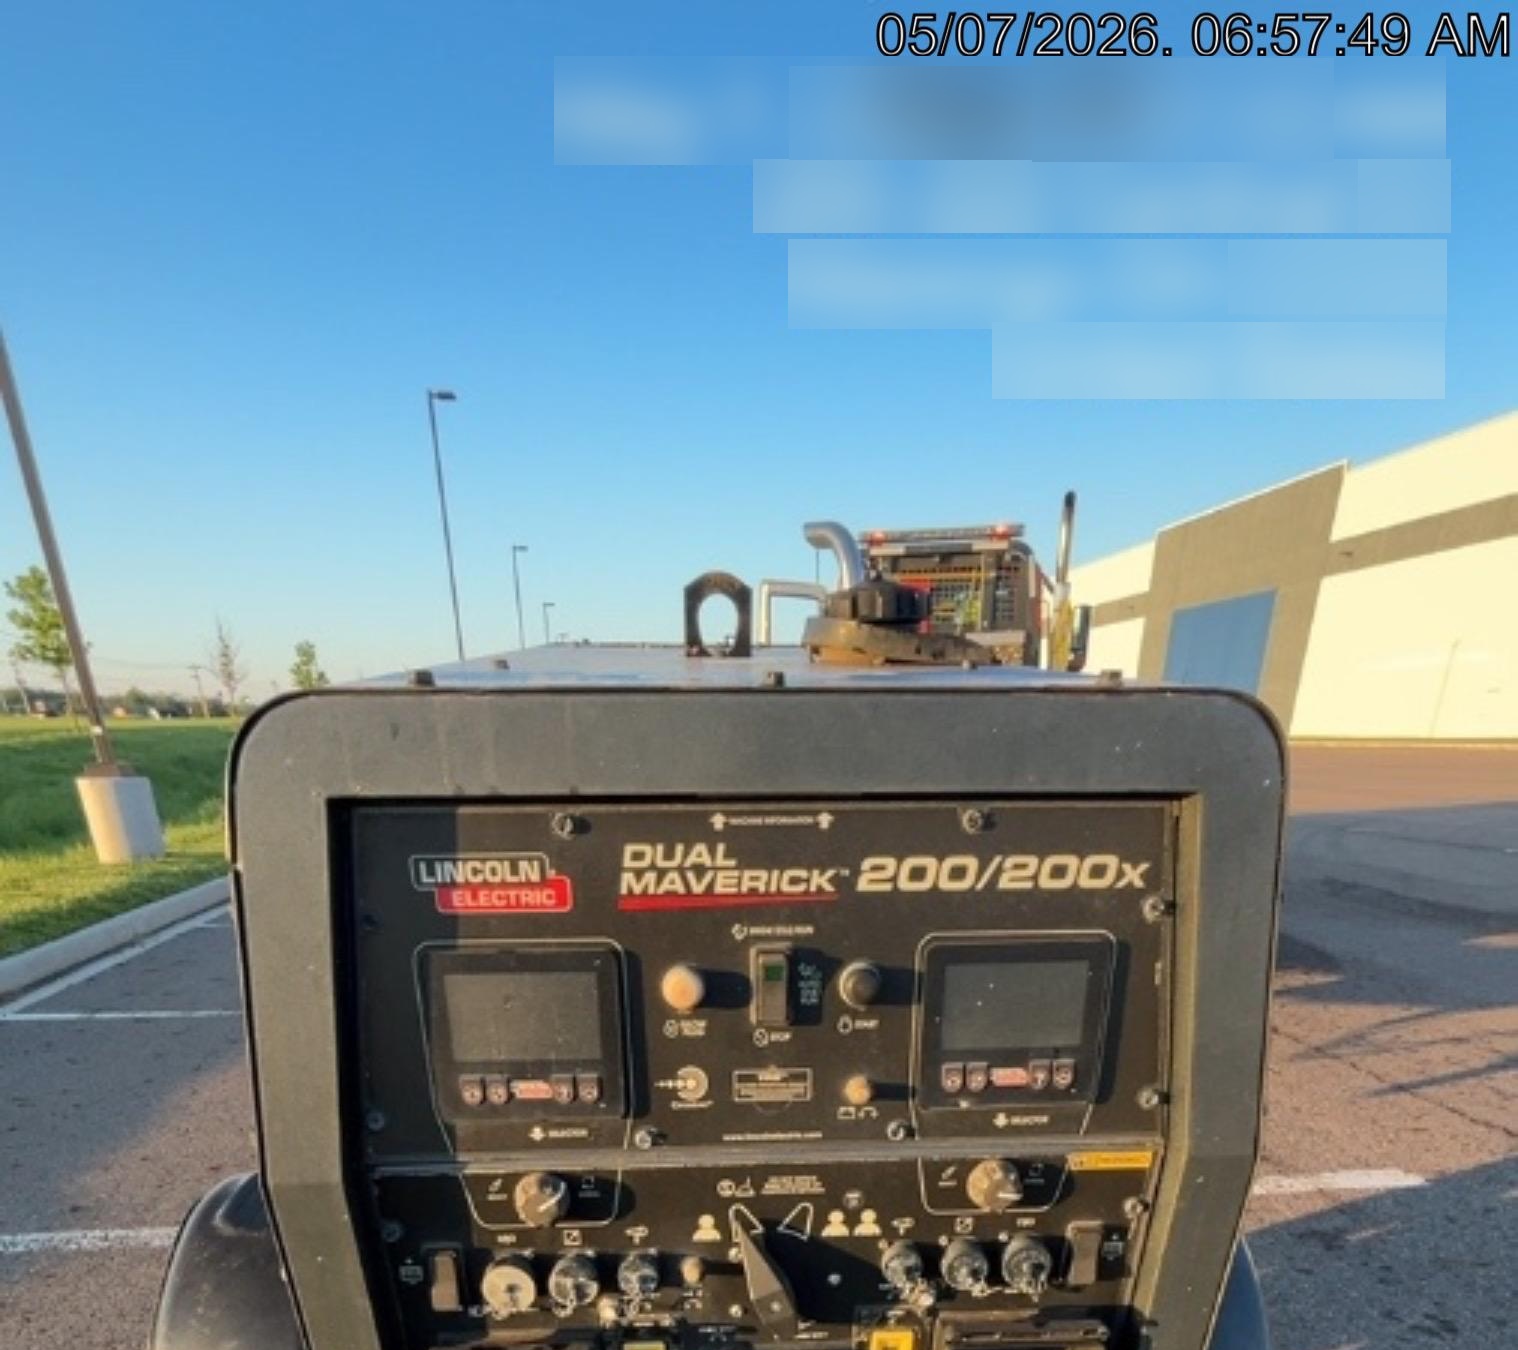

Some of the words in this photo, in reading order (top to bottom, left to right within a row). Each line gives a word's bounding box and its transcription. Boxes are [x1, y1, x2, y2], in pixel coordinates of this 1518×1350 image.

[623, 842, 737, 868] DUAL
[418, 859, 541, 883] LINCOLN
[856, 853, 1150, 892] 200/200x
[451, 888, 557, 907] ELECTRIC
